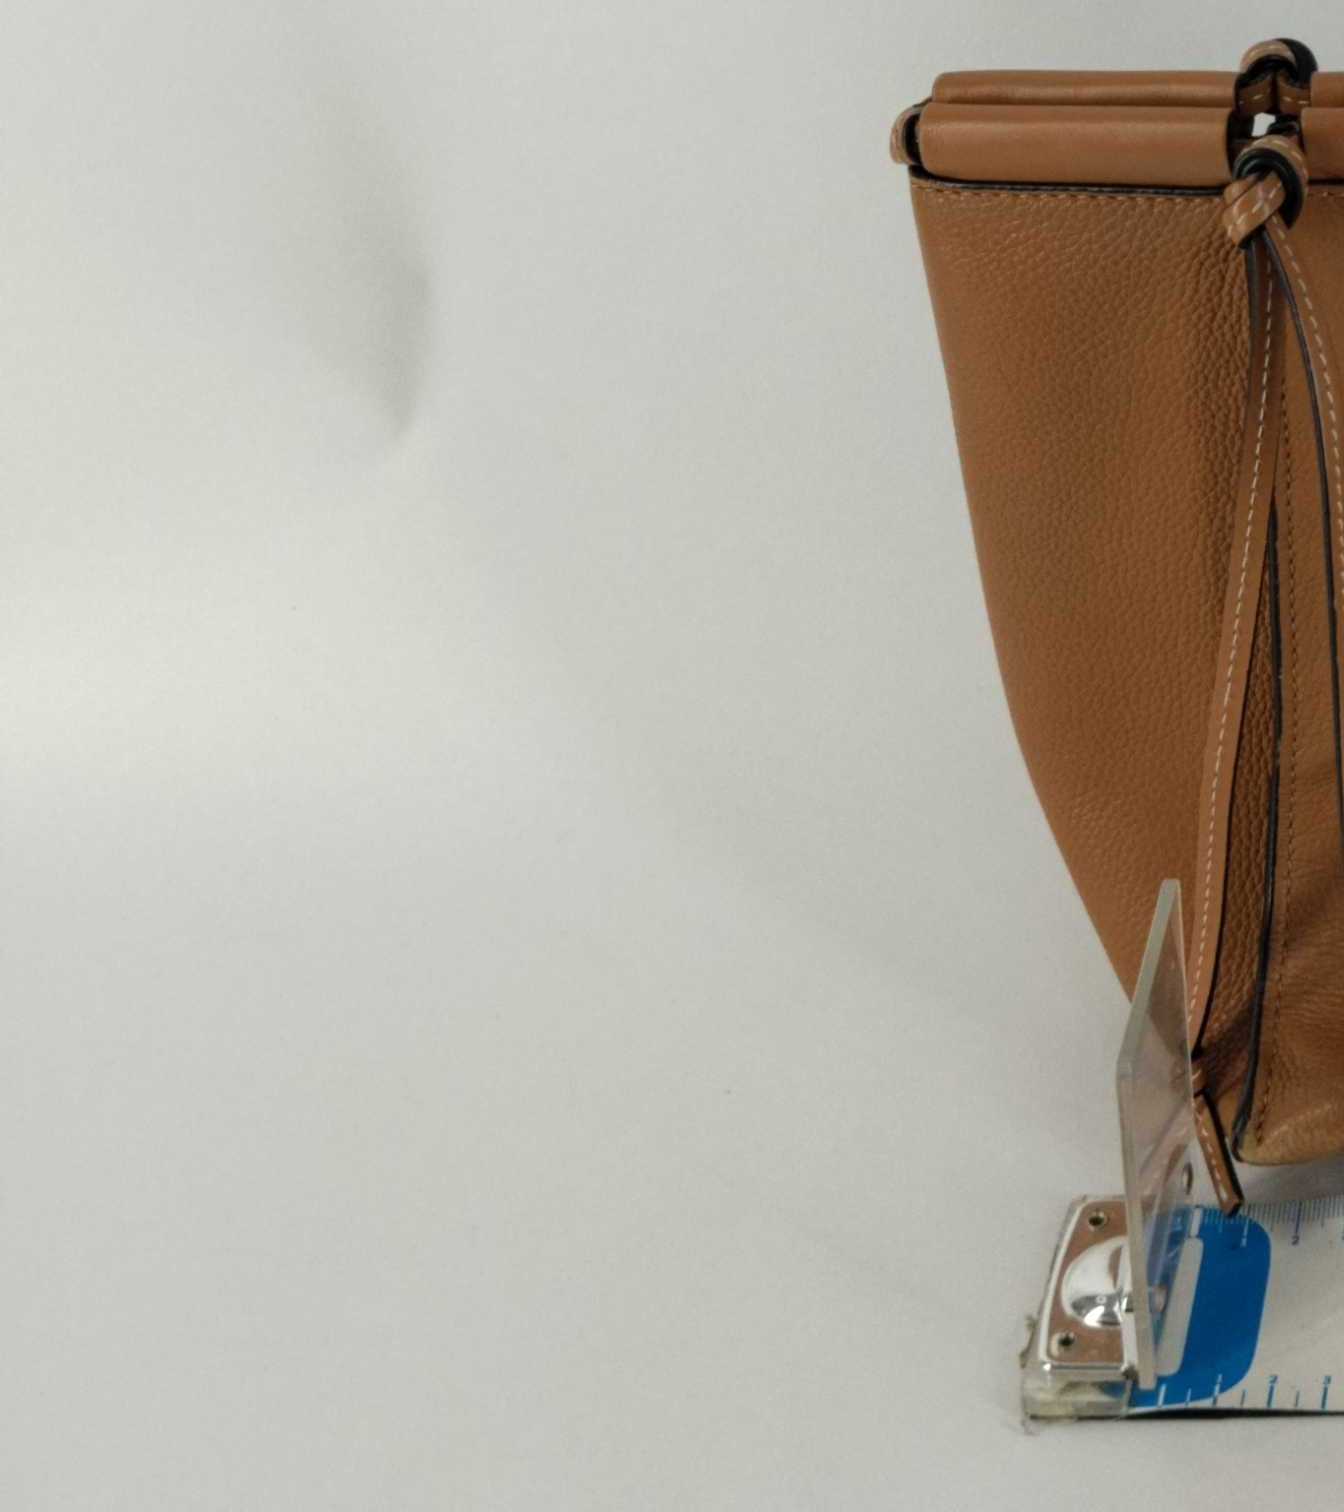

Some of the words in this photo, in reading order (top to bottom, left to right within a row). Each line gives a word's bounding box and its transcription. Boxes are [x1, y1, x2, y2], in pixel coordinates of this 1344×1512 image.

[1292, 1236, 1299, 1245] 2
[1099, 1206, 1272, 1407] 0
[1269, 1374, 1278, 1384] 2
[1323, 1376, 1331, 1385] 3
